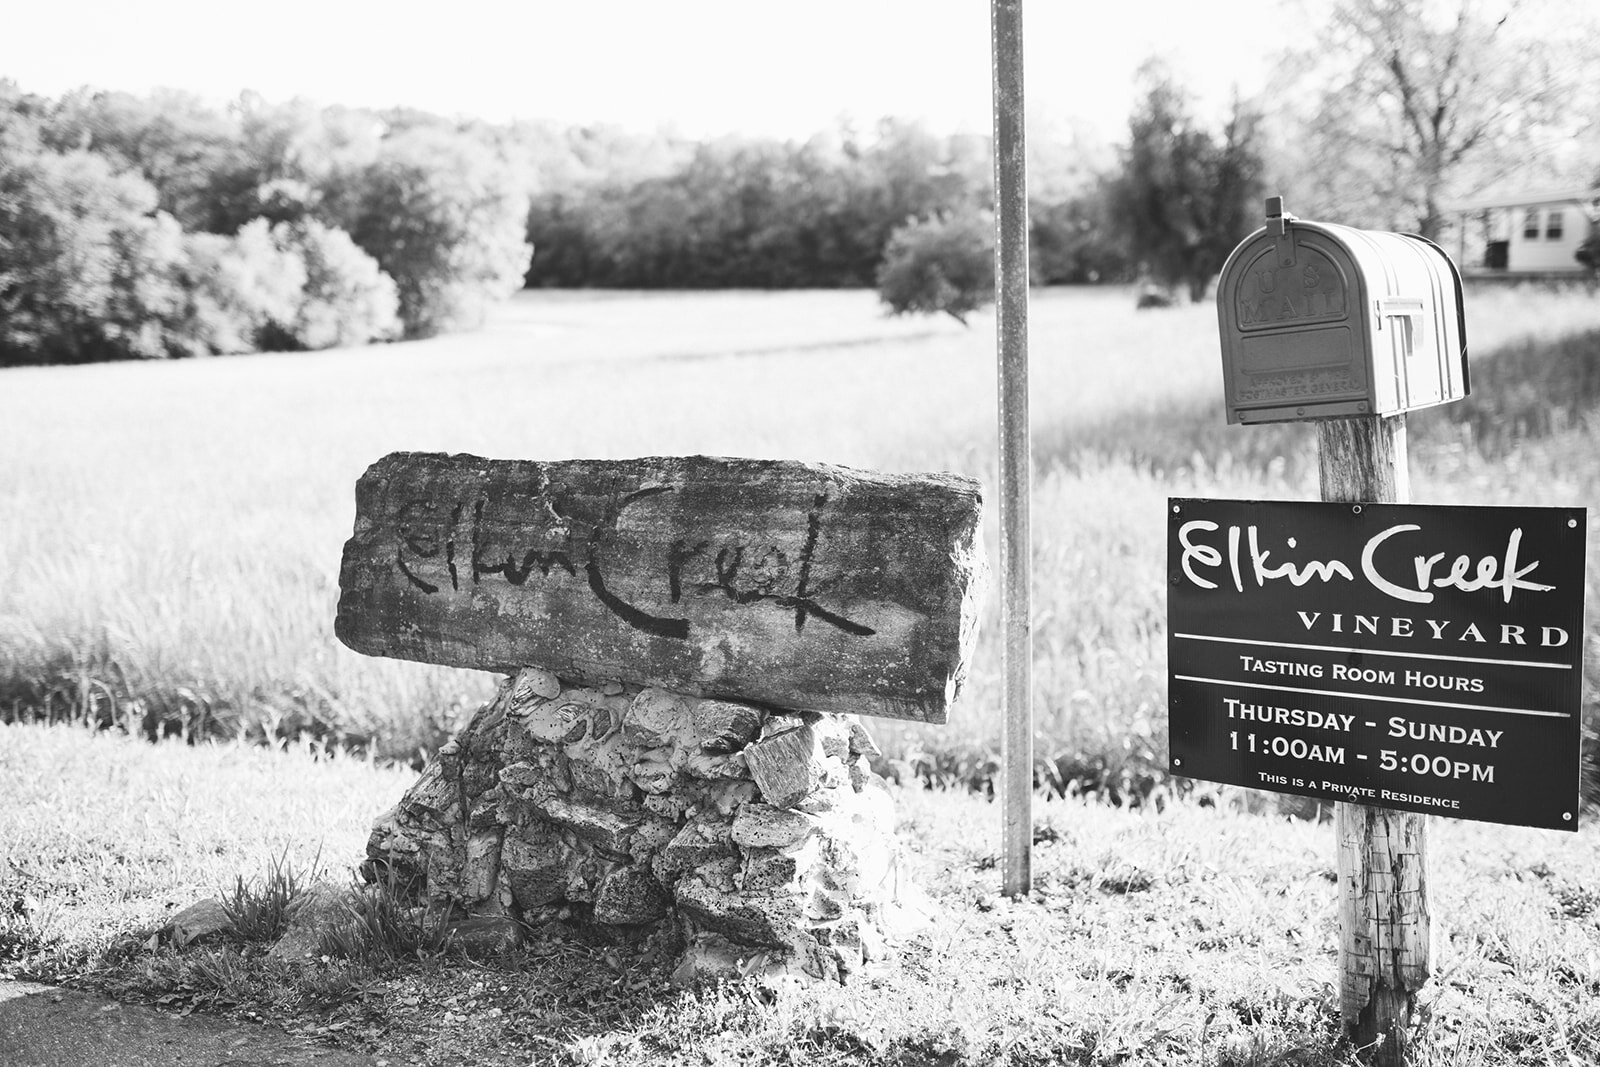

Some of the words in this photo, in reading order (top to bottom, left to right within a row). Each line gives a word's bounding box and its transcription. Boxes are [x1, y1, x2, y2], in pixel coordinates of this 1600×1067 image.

[397, 498, 577, 594] Elkin
[586, 486, 876, 638] Creek
[1178, 520, 1355, 593] Elkin
[1360, 523, 1557, 604] Creek
[1296, 611, 1570, 647] VINEYARD
[1240, 655, 1324, 678] TASTING
[1332, 663, 1396, 685] ROOM
[1404, 669, 1485, 693] HOURS
[1223, 697, 1356, 732] THURSDAY
[1387, 716, 1504, 748] SUNDAY
[1229, 730, 1345, 765] 11:00AM
[1379, 749, 1495, 784] 5:00PM
[1258, 771, 1288, 785] THIS
[1292, 777, 1305, 787] IS
[1308, 780, 1317, 789] A
[1321, 780, 1376, 798] PRIVATE
[1381, 789, 1460, 810] RESIDENCE
